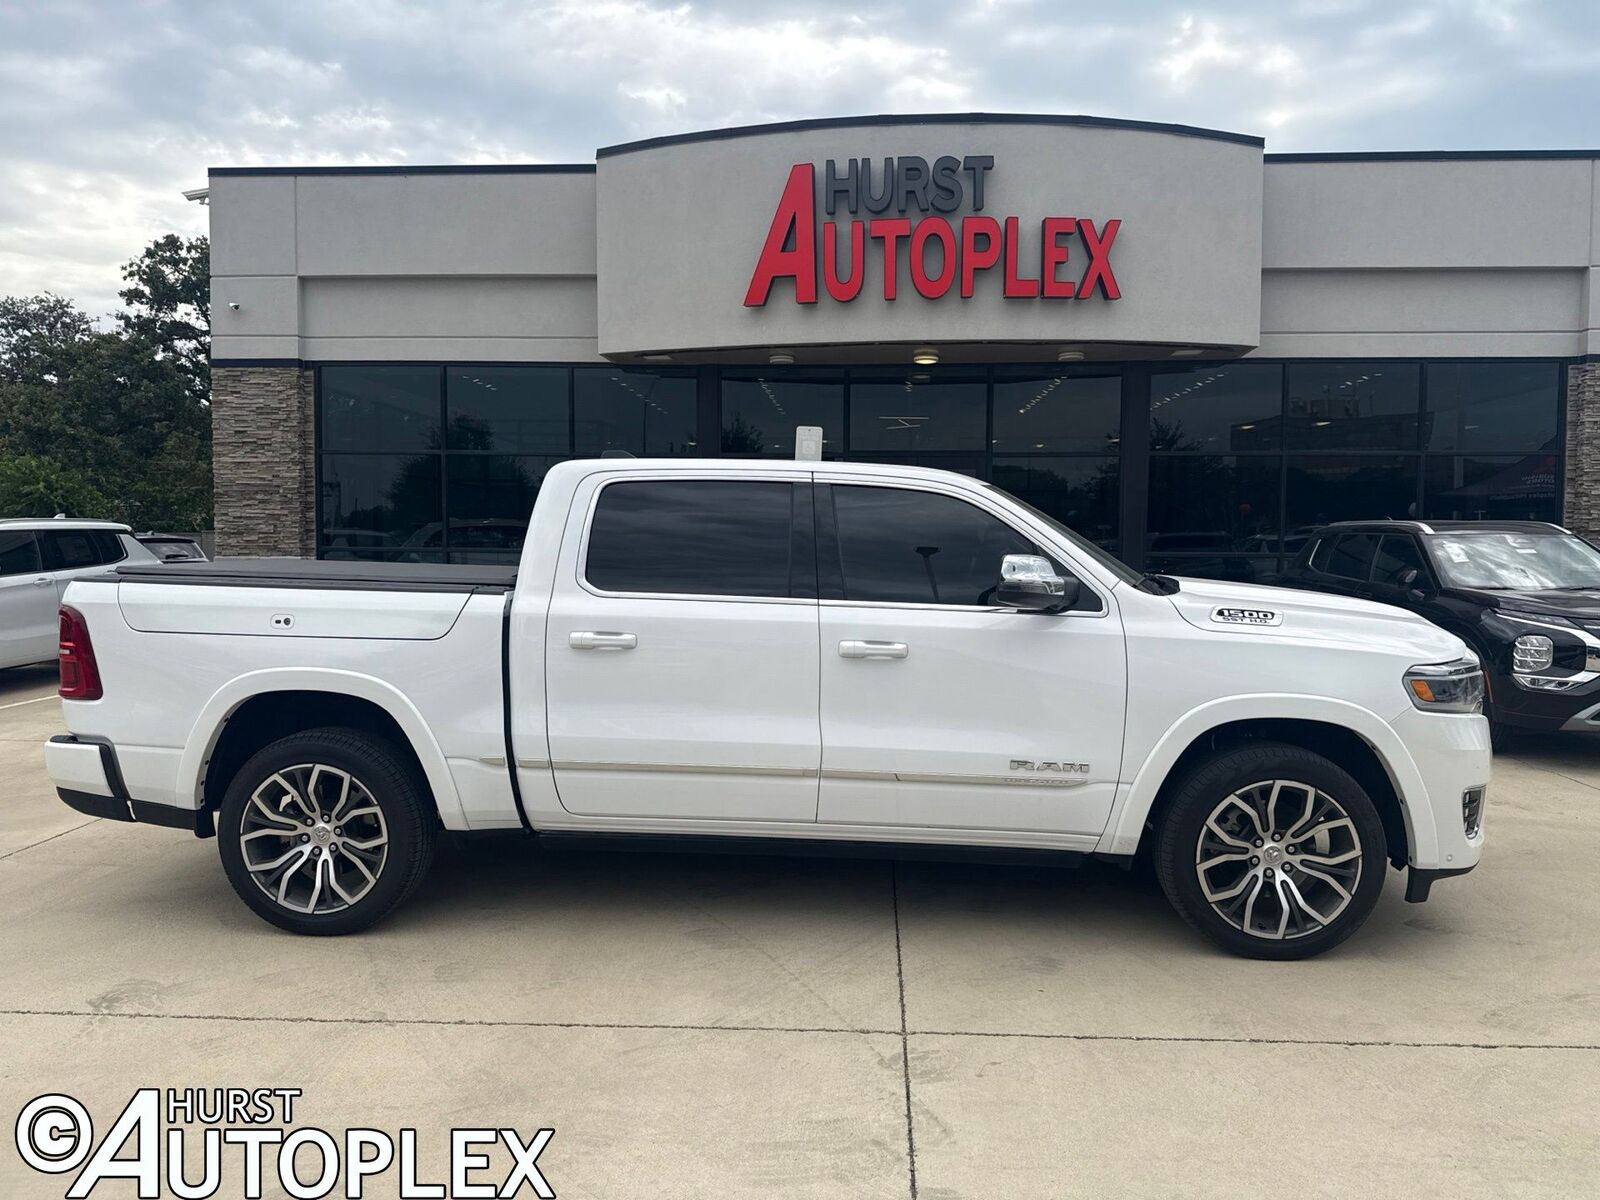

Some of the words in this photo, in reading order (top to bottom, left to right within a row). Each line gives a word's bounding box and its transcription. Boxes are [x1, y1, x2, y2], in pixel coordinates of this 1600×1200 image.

[825, 155, 994, 215] HURST
[743, 163, 1122, 307] AUTOPLEX
[1216, 608, 1275, 620] 1500
[1009, 759, 1090, 774] RAM
